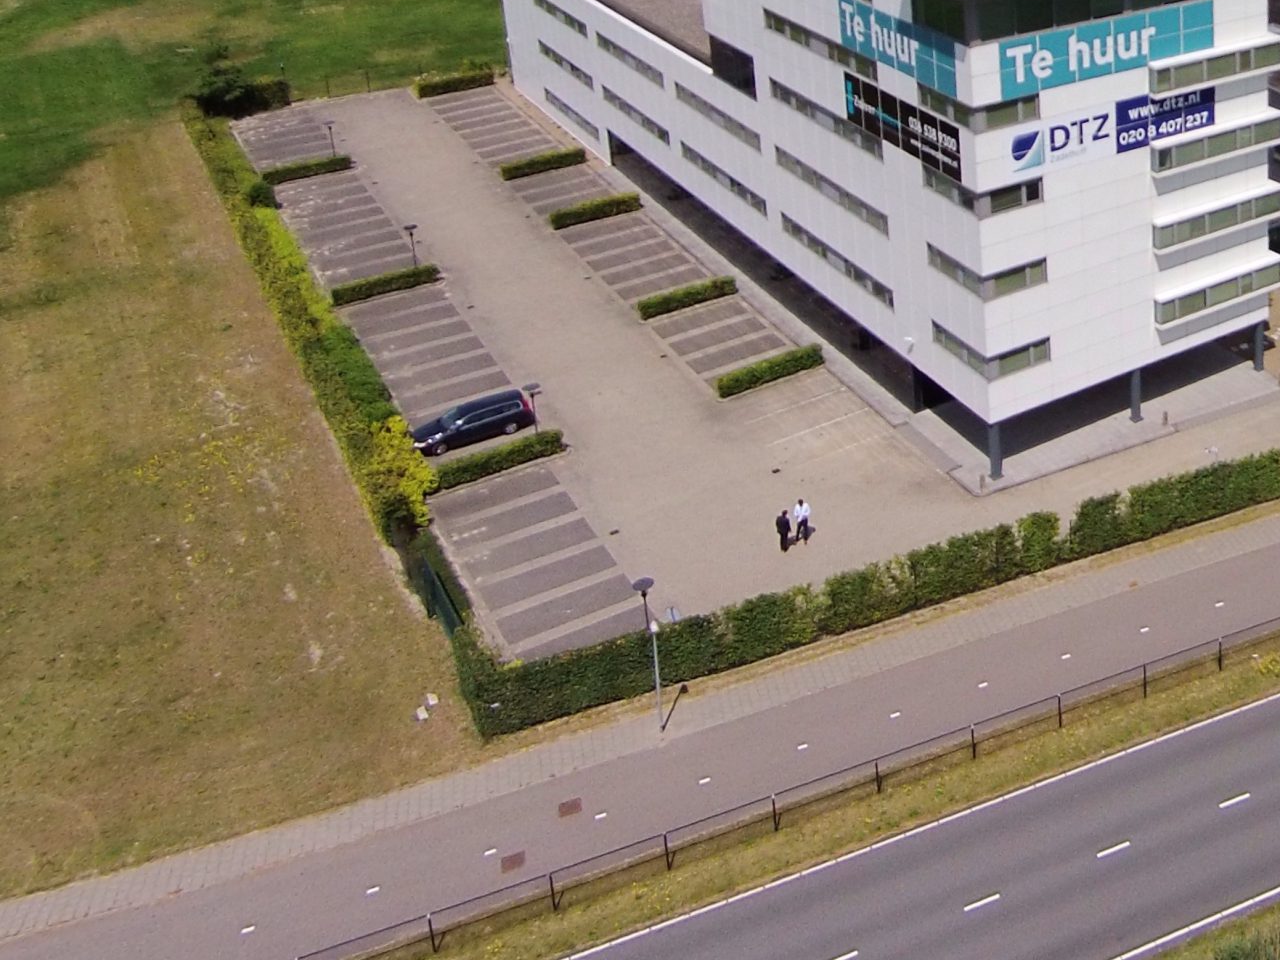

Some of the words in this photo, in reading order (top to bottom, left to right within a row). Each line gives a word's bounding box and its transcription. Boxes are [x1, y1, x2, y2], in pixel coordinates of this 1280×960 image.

[841, 2, 864, 42] Te
[870, 14, 919, 66] huur
[1006, 44, 1054, 83] Te
[1068, 26, 1156, 72] huur
[1128, 91, 1200, 119] www.dtz.nl
[1050, 113, 1110, 152] DTZ
[1119, 127, 1146, 145] 020
[1148, 125, 1157, 138] 8
[1158, 117, 1182, 134] 407
[1185, 111, 1209, 128] 237
